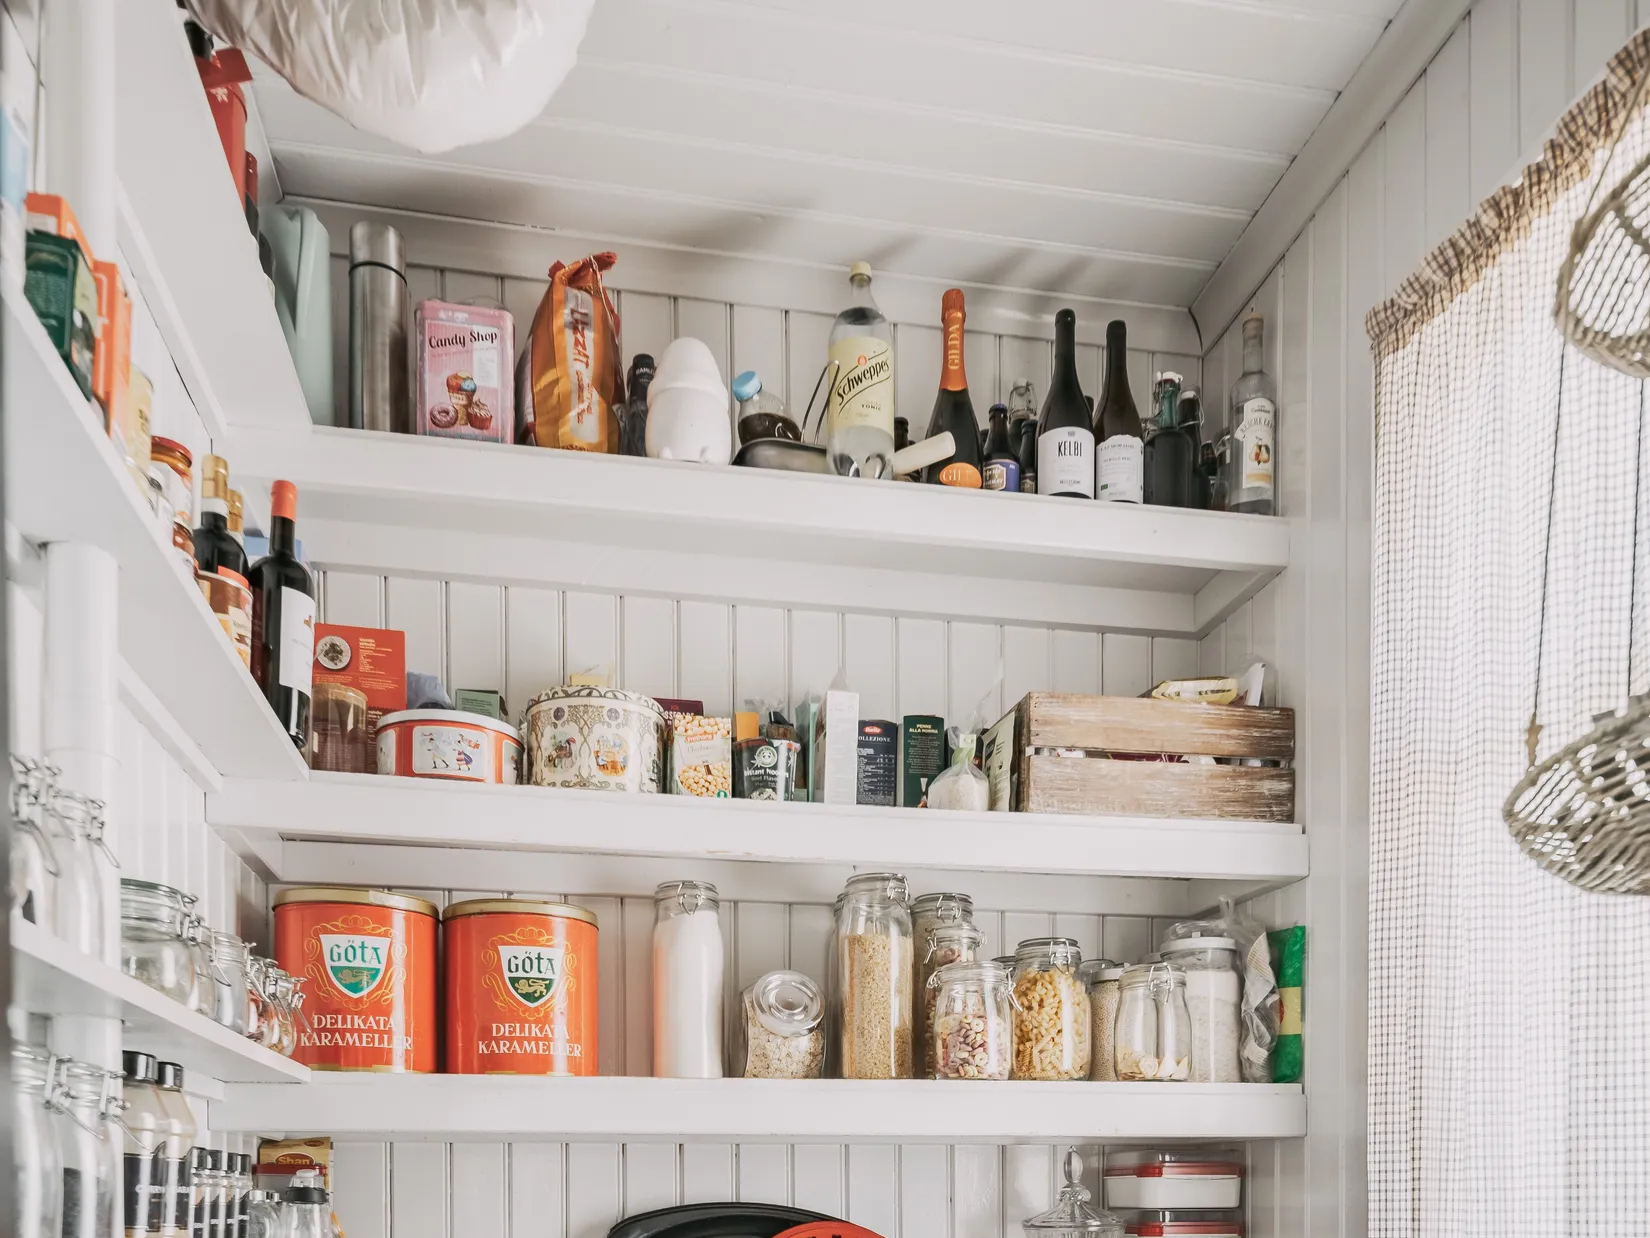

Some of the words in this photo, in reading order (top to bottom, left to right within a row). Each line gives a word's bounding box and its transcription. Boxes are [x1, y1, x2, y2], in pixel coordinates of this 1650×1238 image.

[428, 333, 466, 349] Candy
[469, 329, 498, 344] Shop
[947, 323, 961, 370] GILDA
[836, 358, 890, 406] Schweppes
[1057, 440, 1083, 457] KELBI
[858, 735, 891, 743] OLLEZIONE
[313, 1014, 397, 1031] DELIKATA
[300, 1032, 412, 1050] KARAMELLR
[278, 1156, 311, 1165] Shan
